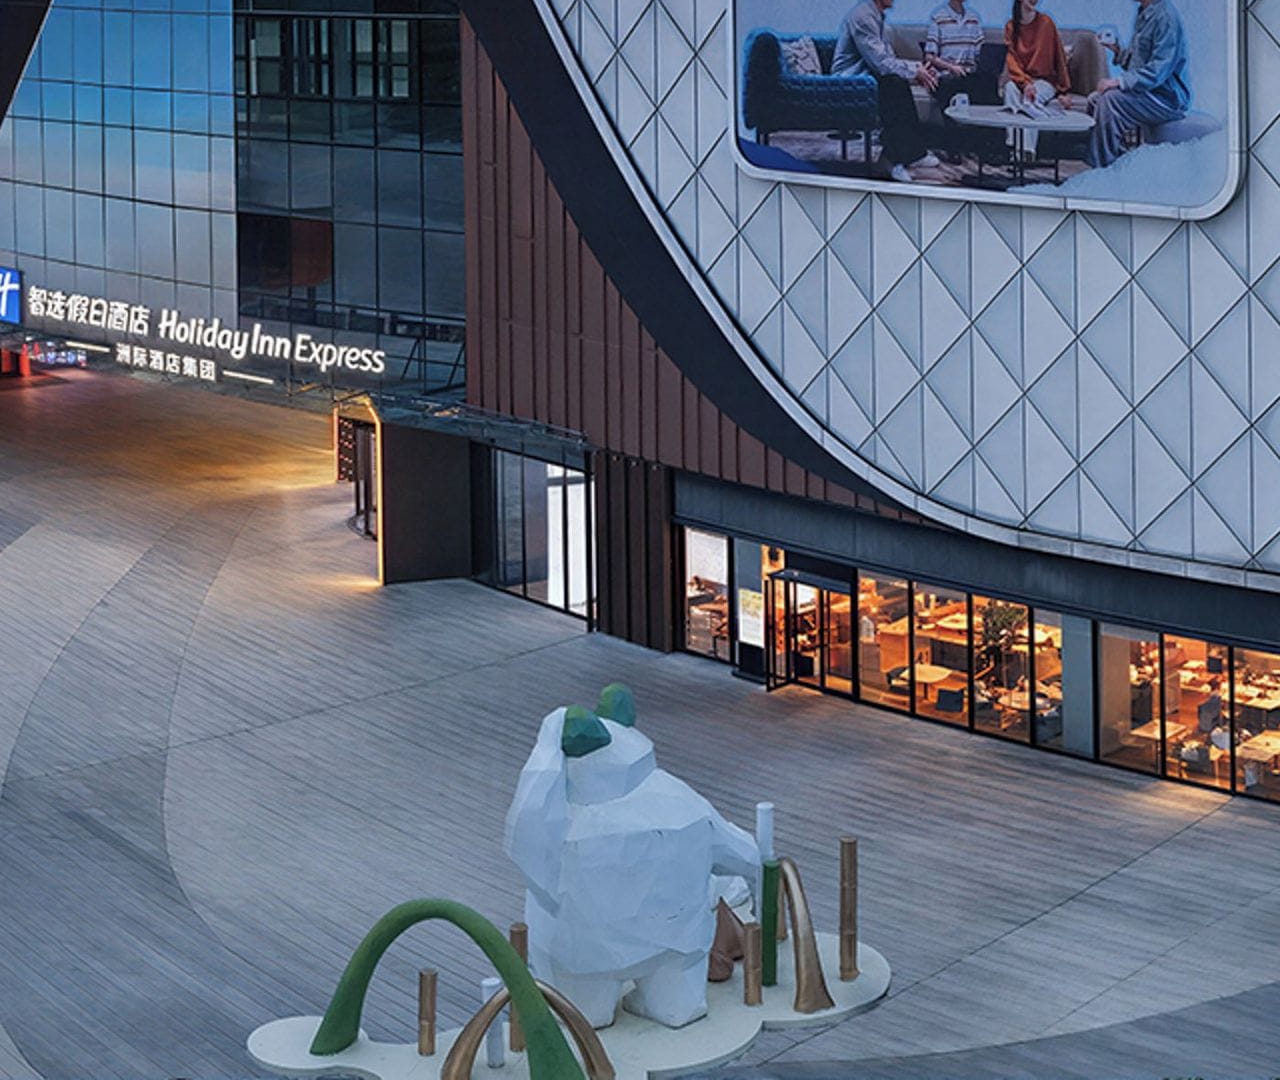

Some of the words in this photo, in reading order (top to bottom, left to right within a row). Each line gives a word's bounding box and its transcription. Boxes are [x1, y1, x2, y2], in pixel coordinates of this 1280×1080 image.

[28, 285, 150, 336] 智选假日酒店
[158, 309, 248, 359] Holiday
[251, 323, 292, 359] Inn
[294, 333, 386, 373] Express
[115, 343, 217, 381] 洲际酒店集团
